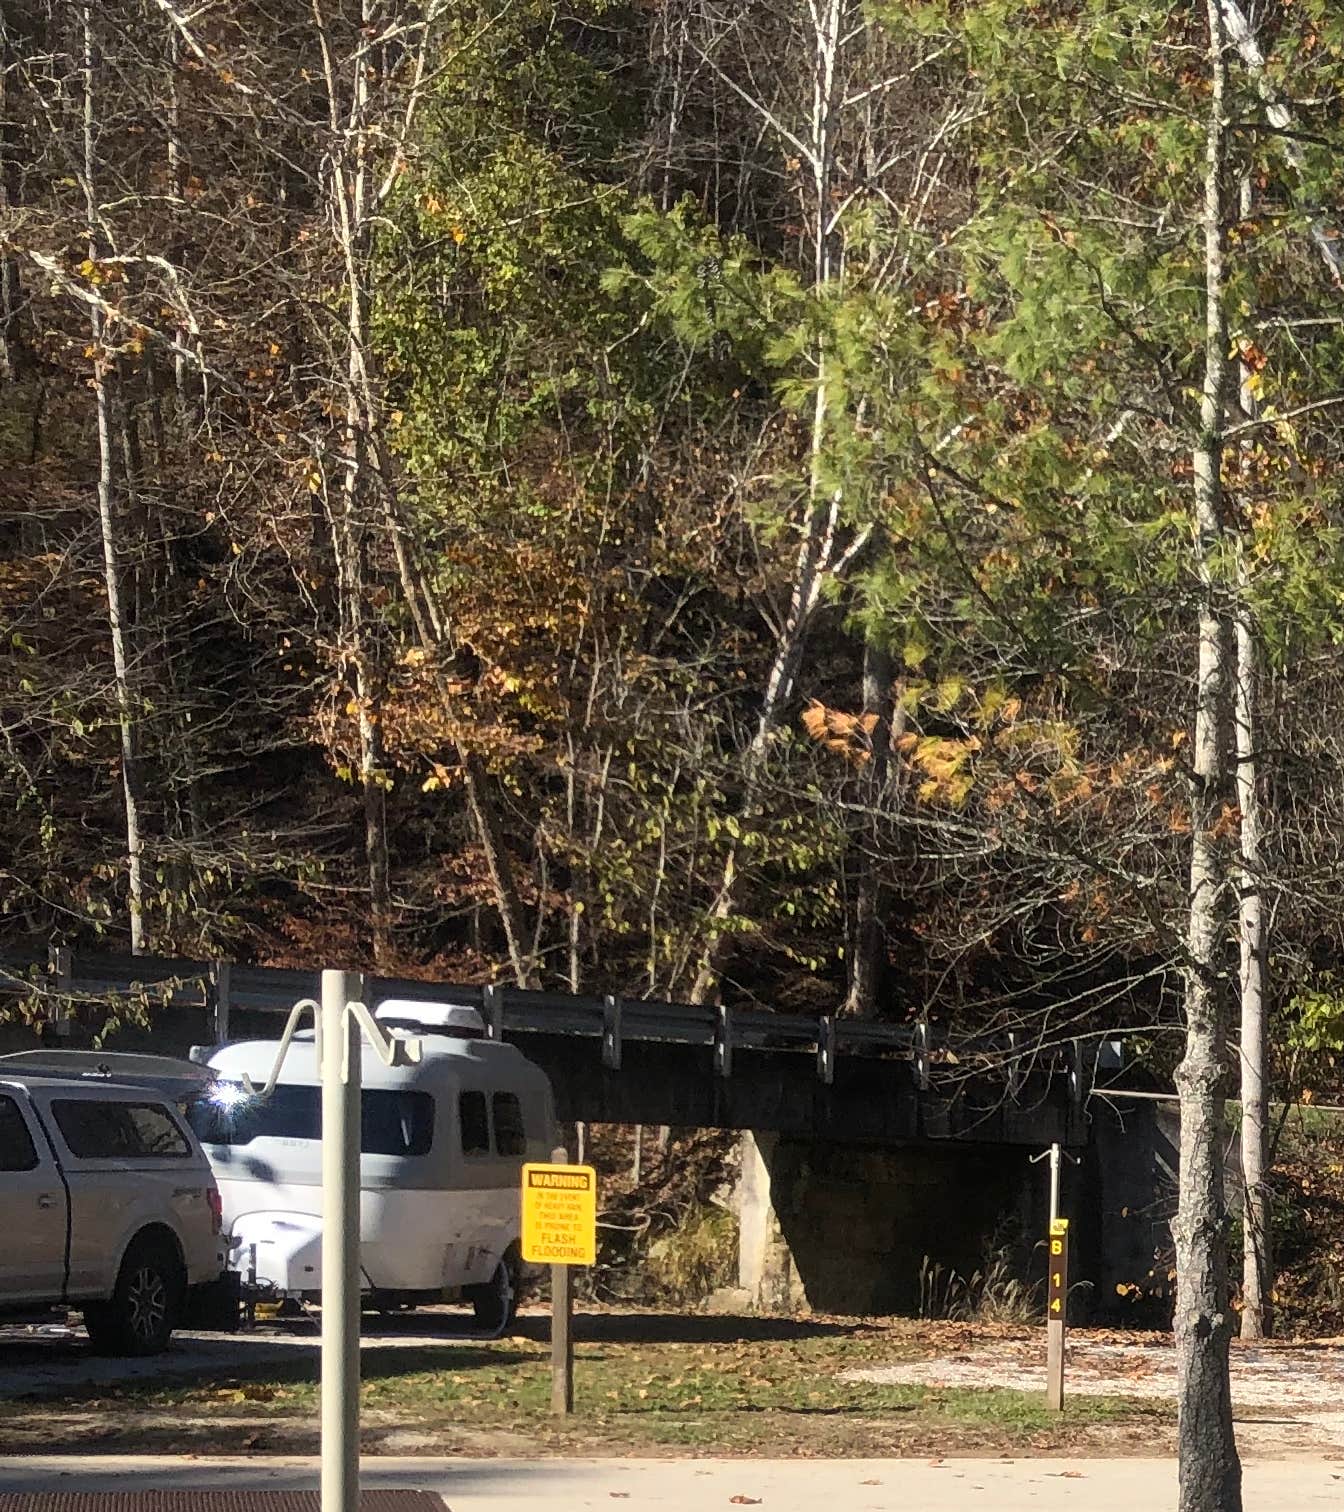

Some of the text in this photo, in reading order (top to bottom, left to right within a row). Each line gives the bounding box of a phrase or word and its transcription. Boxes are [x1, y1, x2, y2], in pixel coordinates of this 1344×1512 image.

[531, 1173, 588, 1189] WARNING
[541, 1233, 577, 1245] FLASH
[531, 1245, 586, 1259] FLOODING
[1051, 1240, 1062, 1255] B
